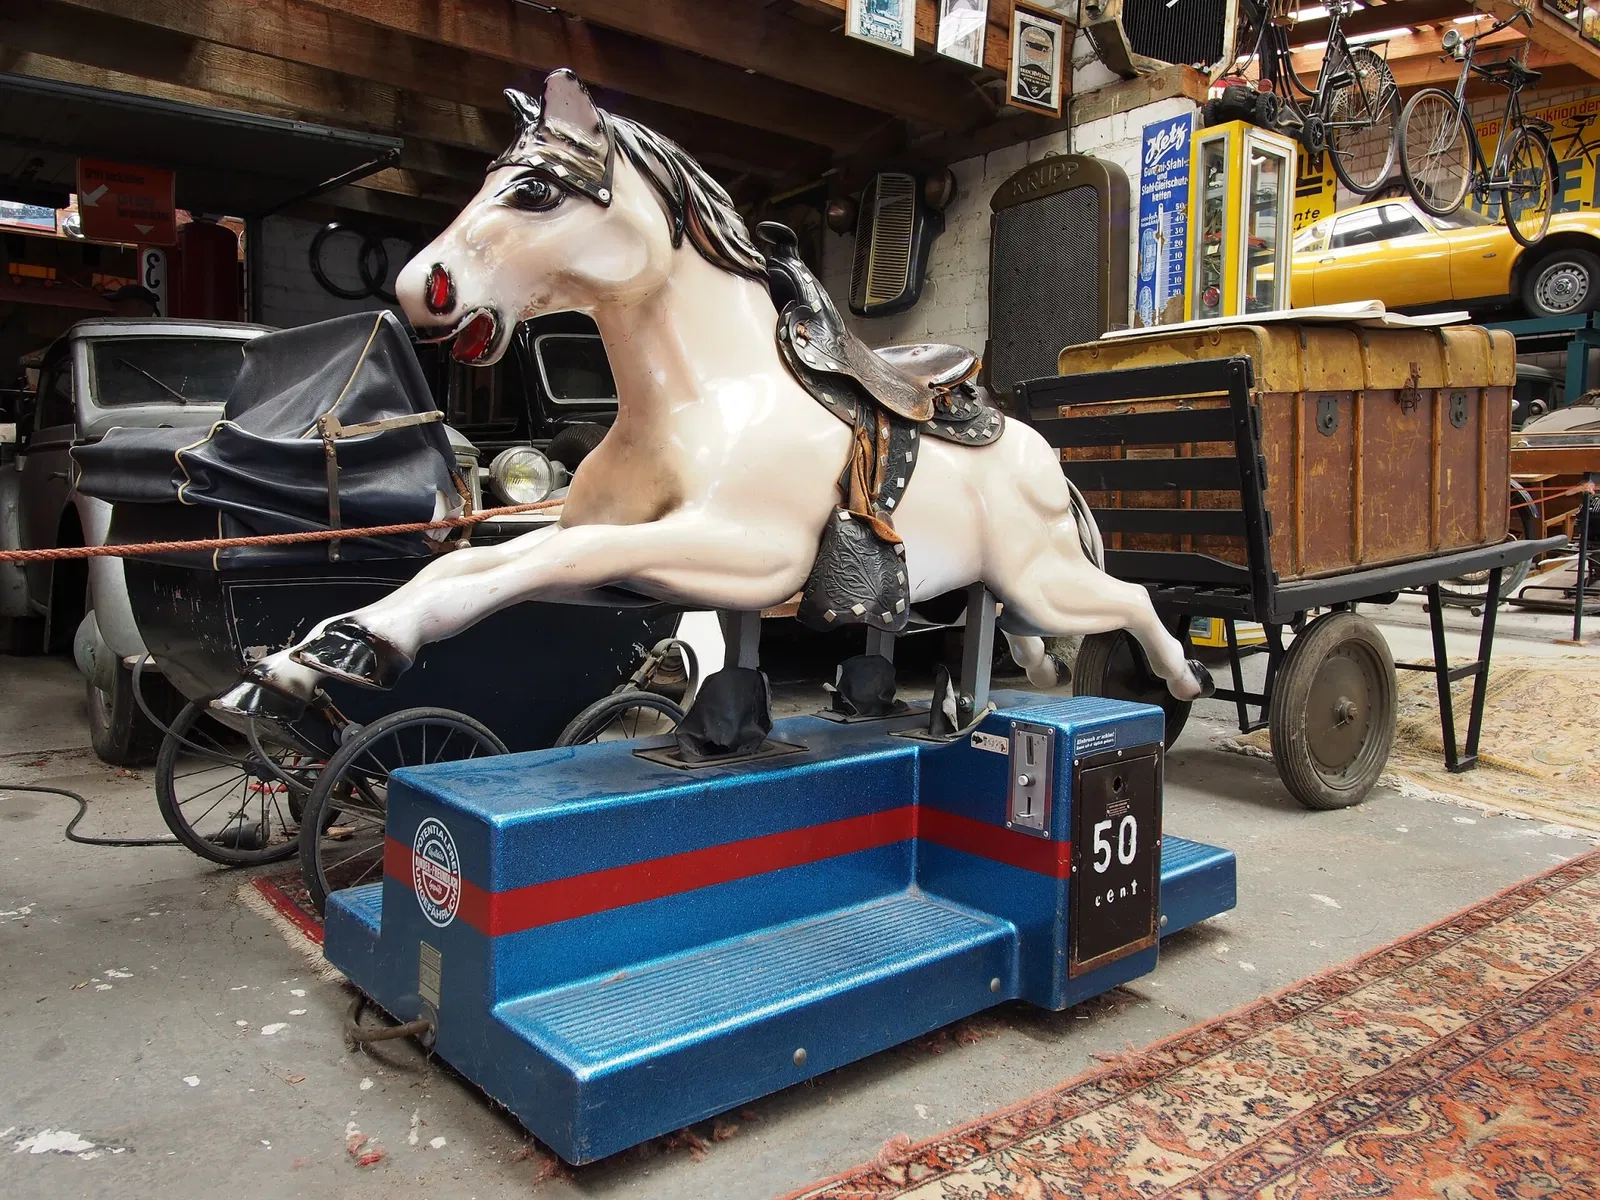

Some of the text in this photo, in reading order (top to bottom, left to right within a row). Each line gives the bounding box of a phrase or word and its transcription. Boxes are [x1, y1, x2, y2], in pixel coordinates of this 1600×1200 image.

[1012, 160, 1079, 197] KRUPP
[415, 824, 458, 875] POTENTIALFREI
[1092, 815, 1138, 874] 50
[415, 866, 458, 920] UNGEFÄHRLICH
[1094, 879, 1138, 908] cent
